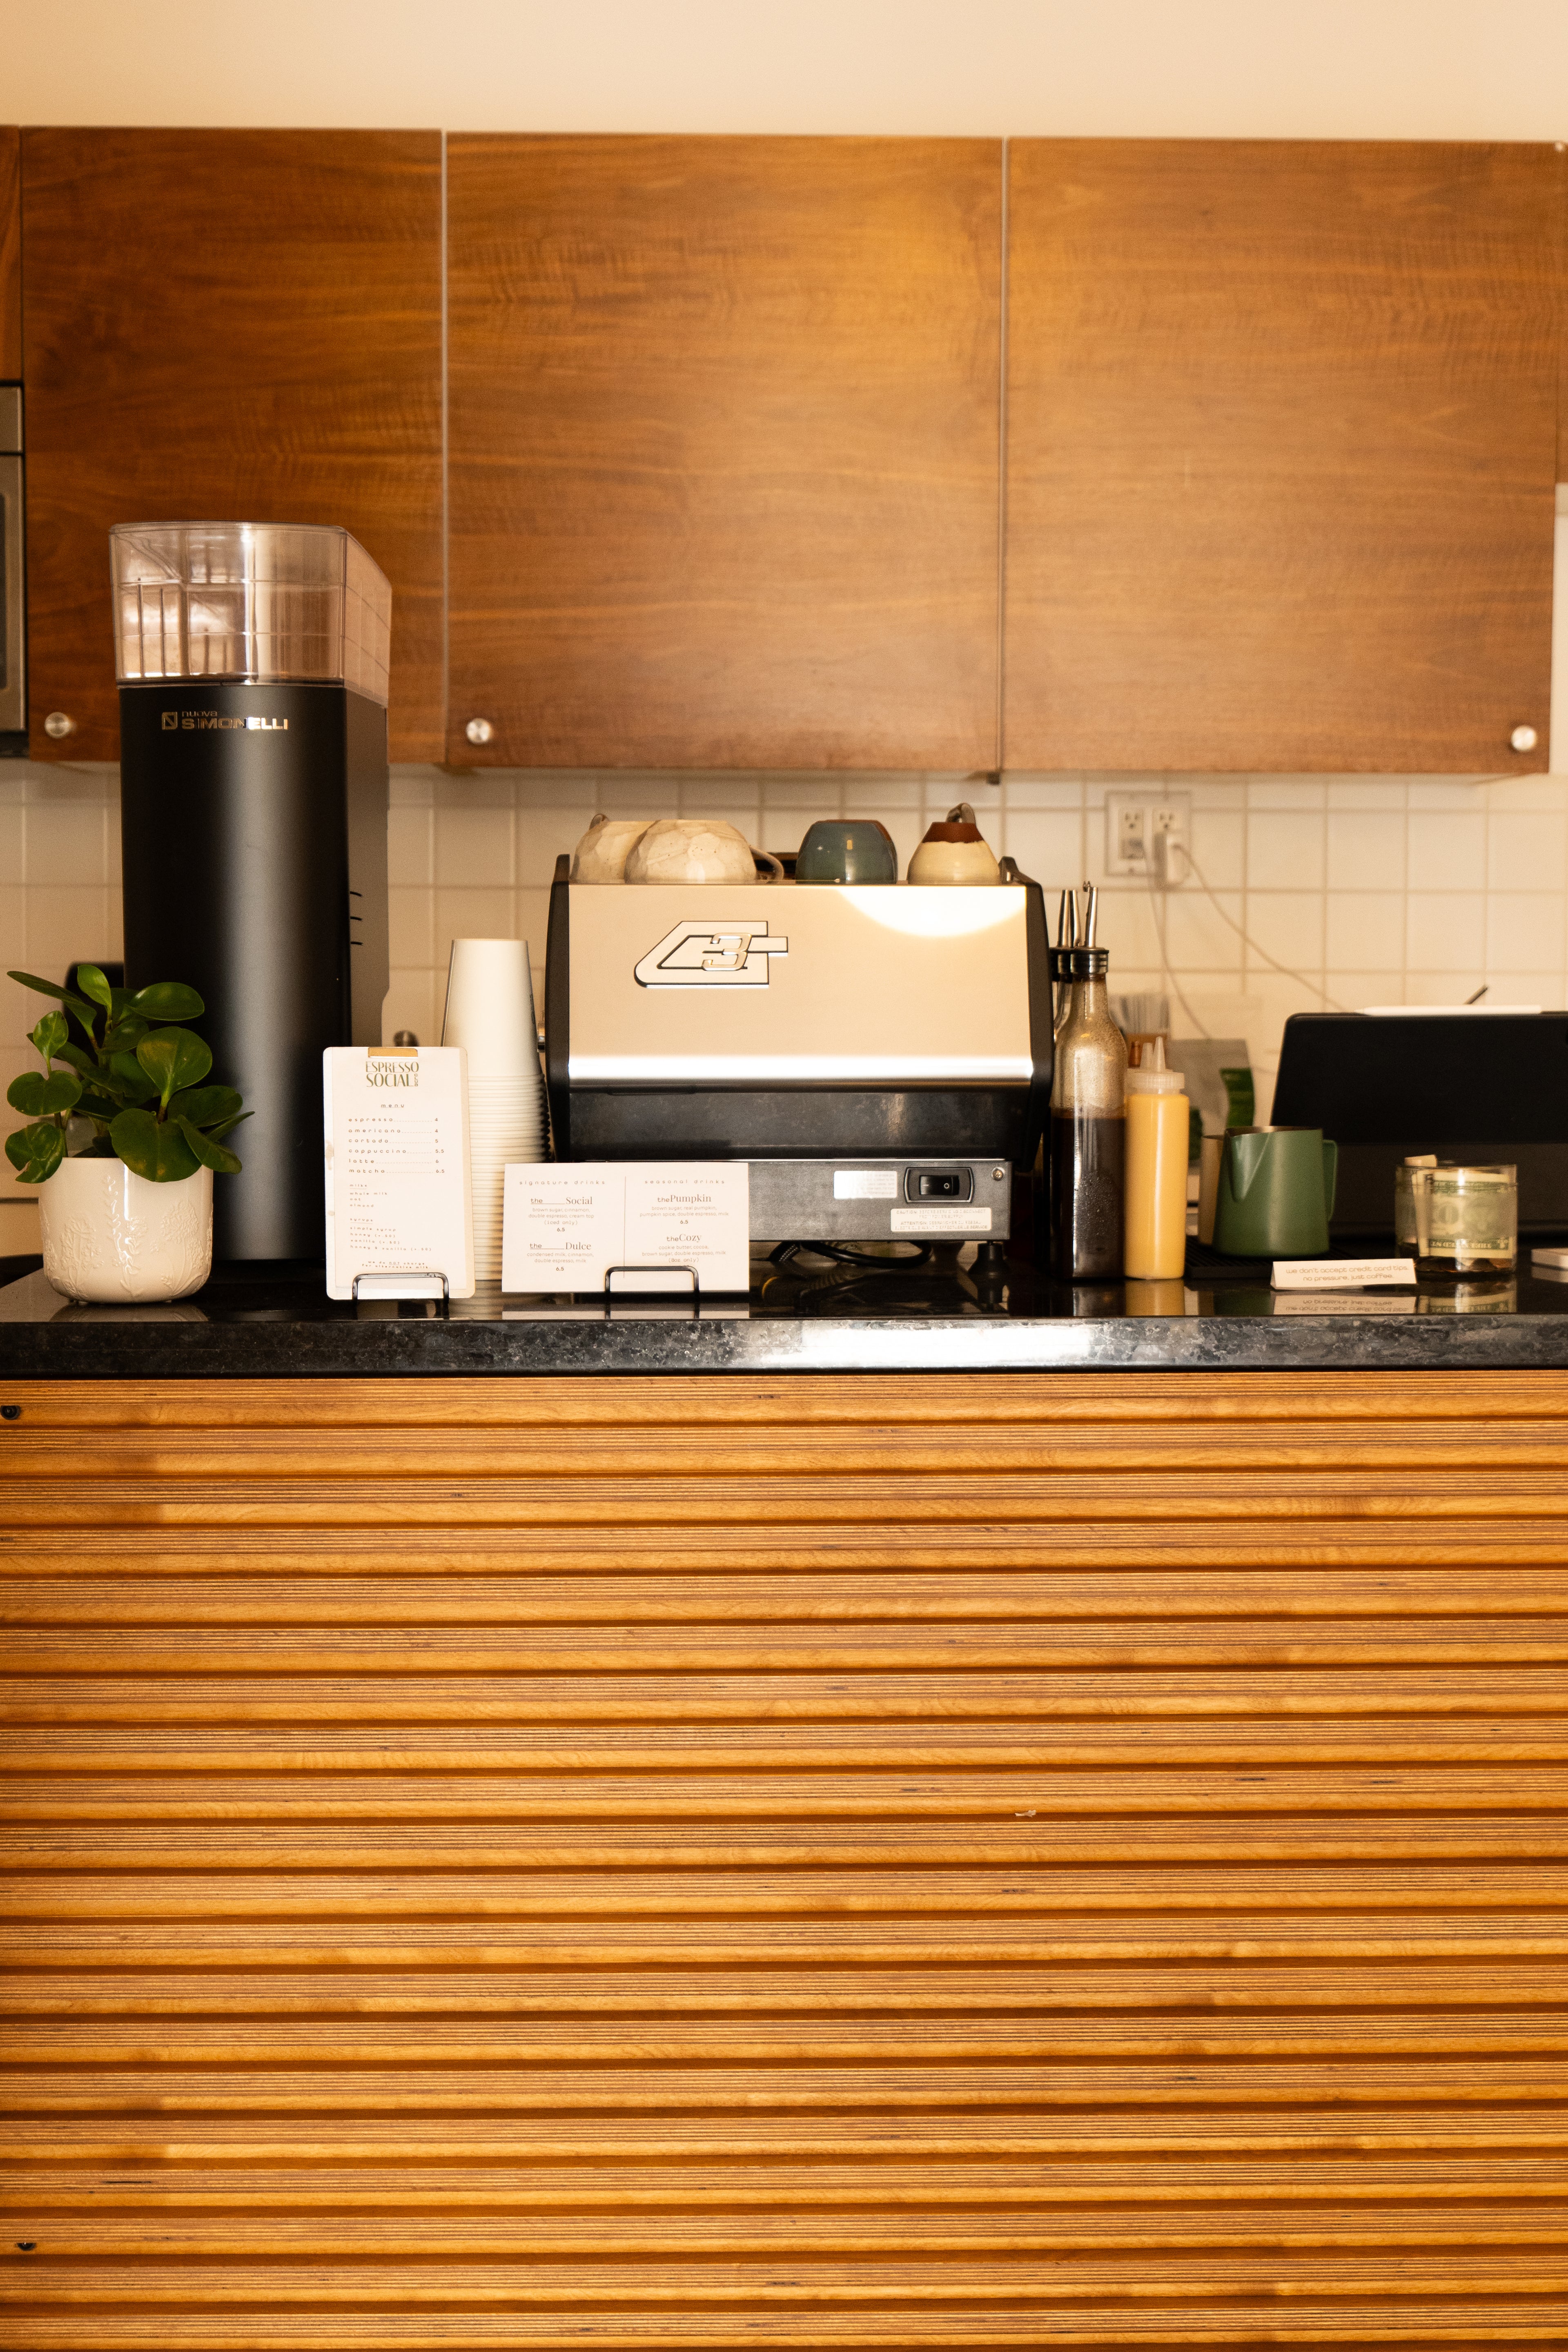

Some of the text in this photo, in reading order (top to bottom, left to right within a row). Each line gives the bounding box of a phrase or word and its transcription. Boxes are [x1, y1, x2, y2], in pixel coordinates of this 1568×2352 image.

[182, 717, 288, 729] SIMONELLI
[365, 1061, 419, 1073] ESPRESSO
[366, 1073, 414, 1087] SOCIAL
